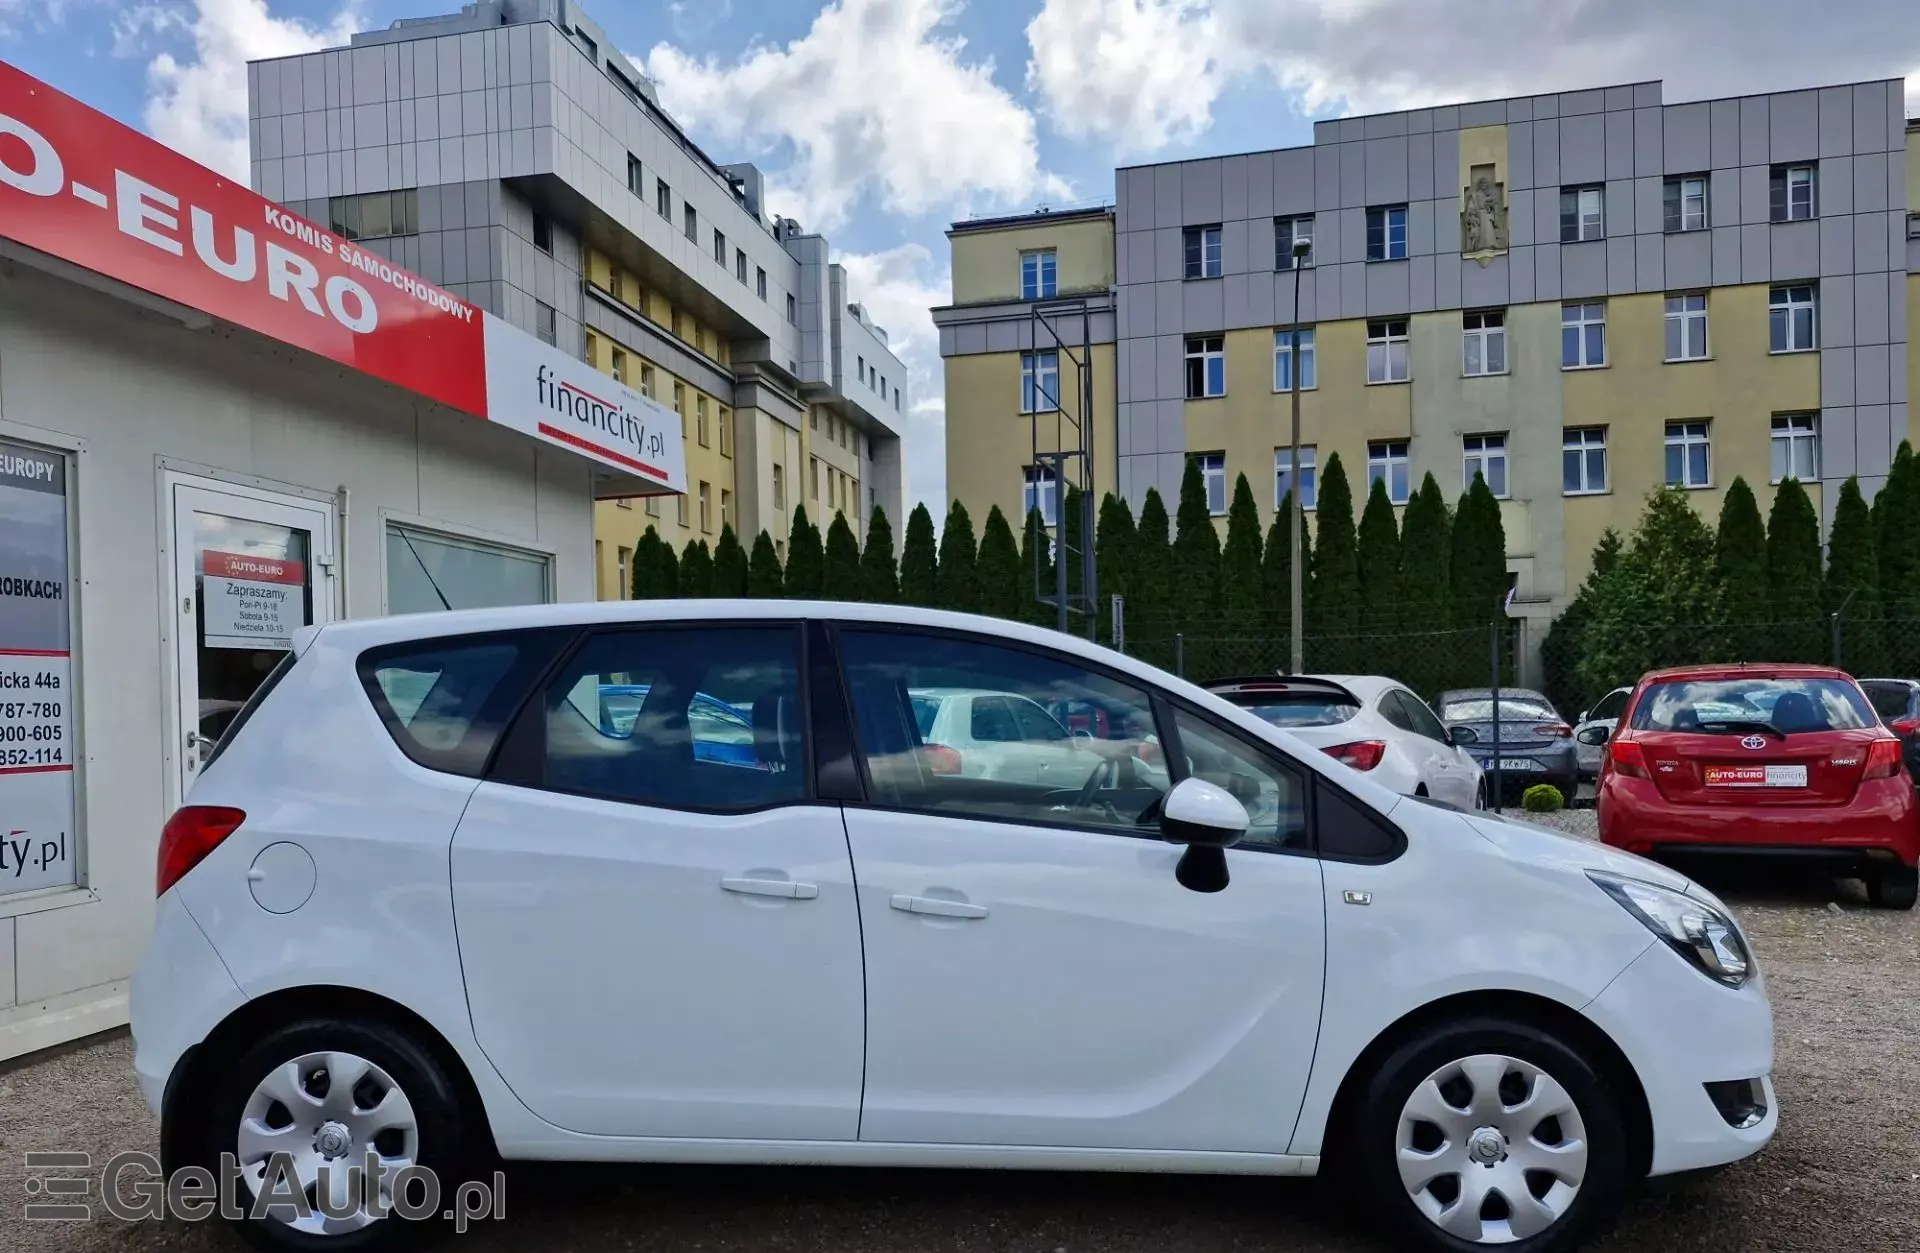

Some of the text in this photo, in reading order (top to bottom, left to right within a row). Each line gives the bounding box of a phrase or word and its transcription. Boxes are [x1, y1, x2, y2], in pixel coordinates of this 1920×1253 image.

[264, 205, 473, 323] KOMIS SAMOCHODOWY
[537, 365, 665, 458] financity.pl
[231, 561, 284, 576] AUTO-EURO
[226, 582, 288, 602] Zapraszamy:
[263, 602, 278, 611] 9-18
[239, 611, 279, 622] Sobota 9-15
[233, 622, 284, 633] Niedziela 10-15
[35, 671, 61, 689] 44a
[1709, 771, 1763, 779] AUTO-EURO
